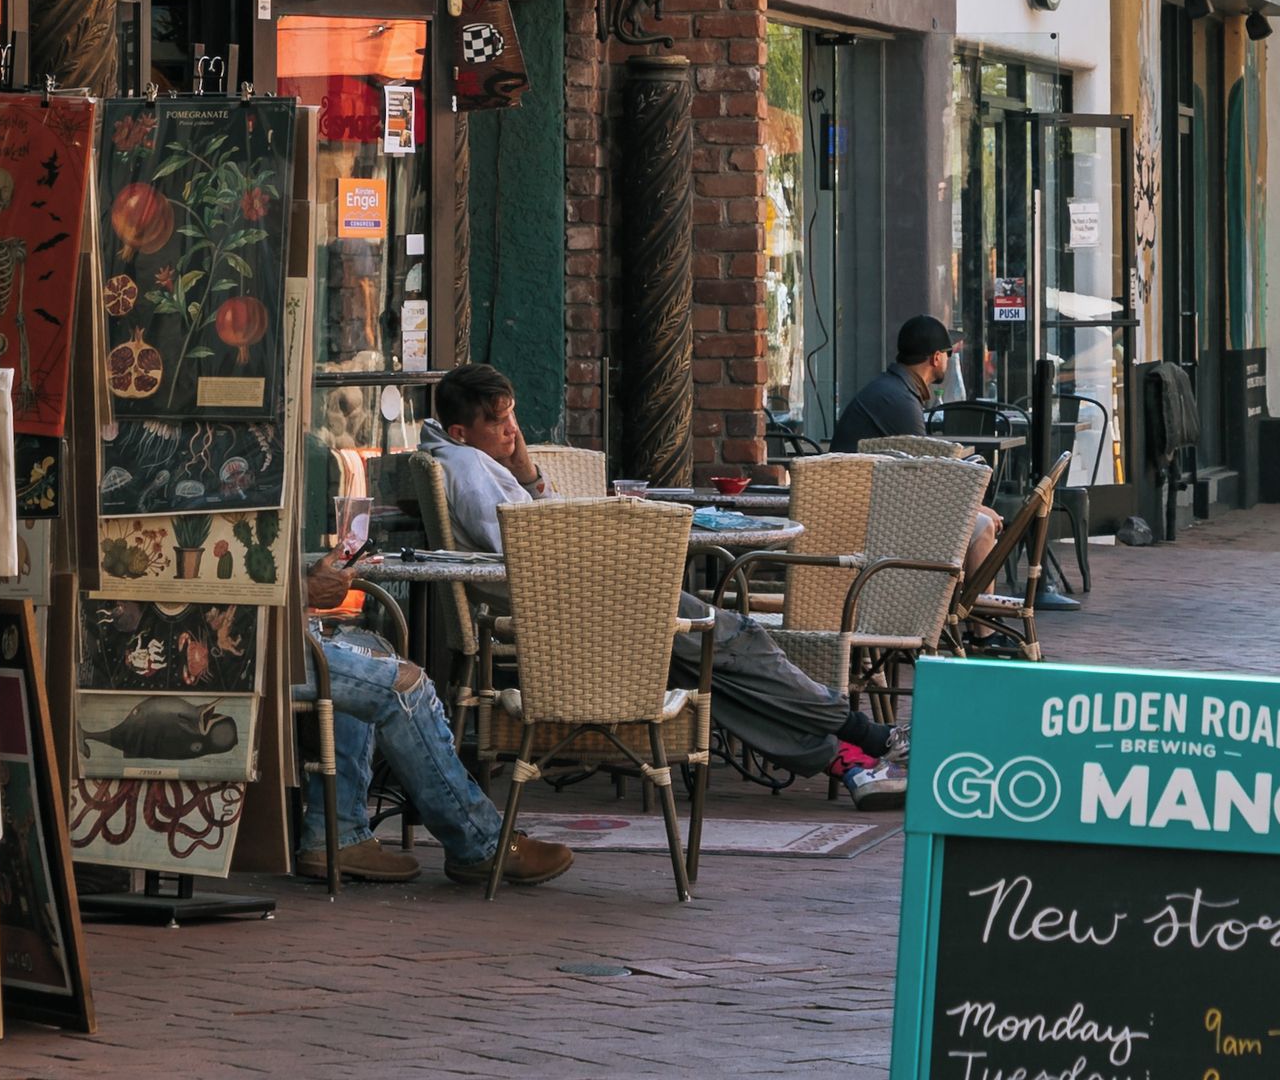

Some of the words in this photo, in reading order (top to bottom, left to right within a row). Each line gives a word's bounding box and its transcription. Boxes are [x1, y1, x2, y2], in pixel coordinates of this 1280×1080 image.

[166, 110, 229, 119] POMEGRANATE
[346, 193, 379, 210] Engel
[999, 308, 1020, 319] PUSH
[1041, 691, 1189, 739] GOLDEN
[1120, 737, 1218, 759] BREWING
[932, 751, 1062, 823] GO
[968, 875, 1127, 945] New
